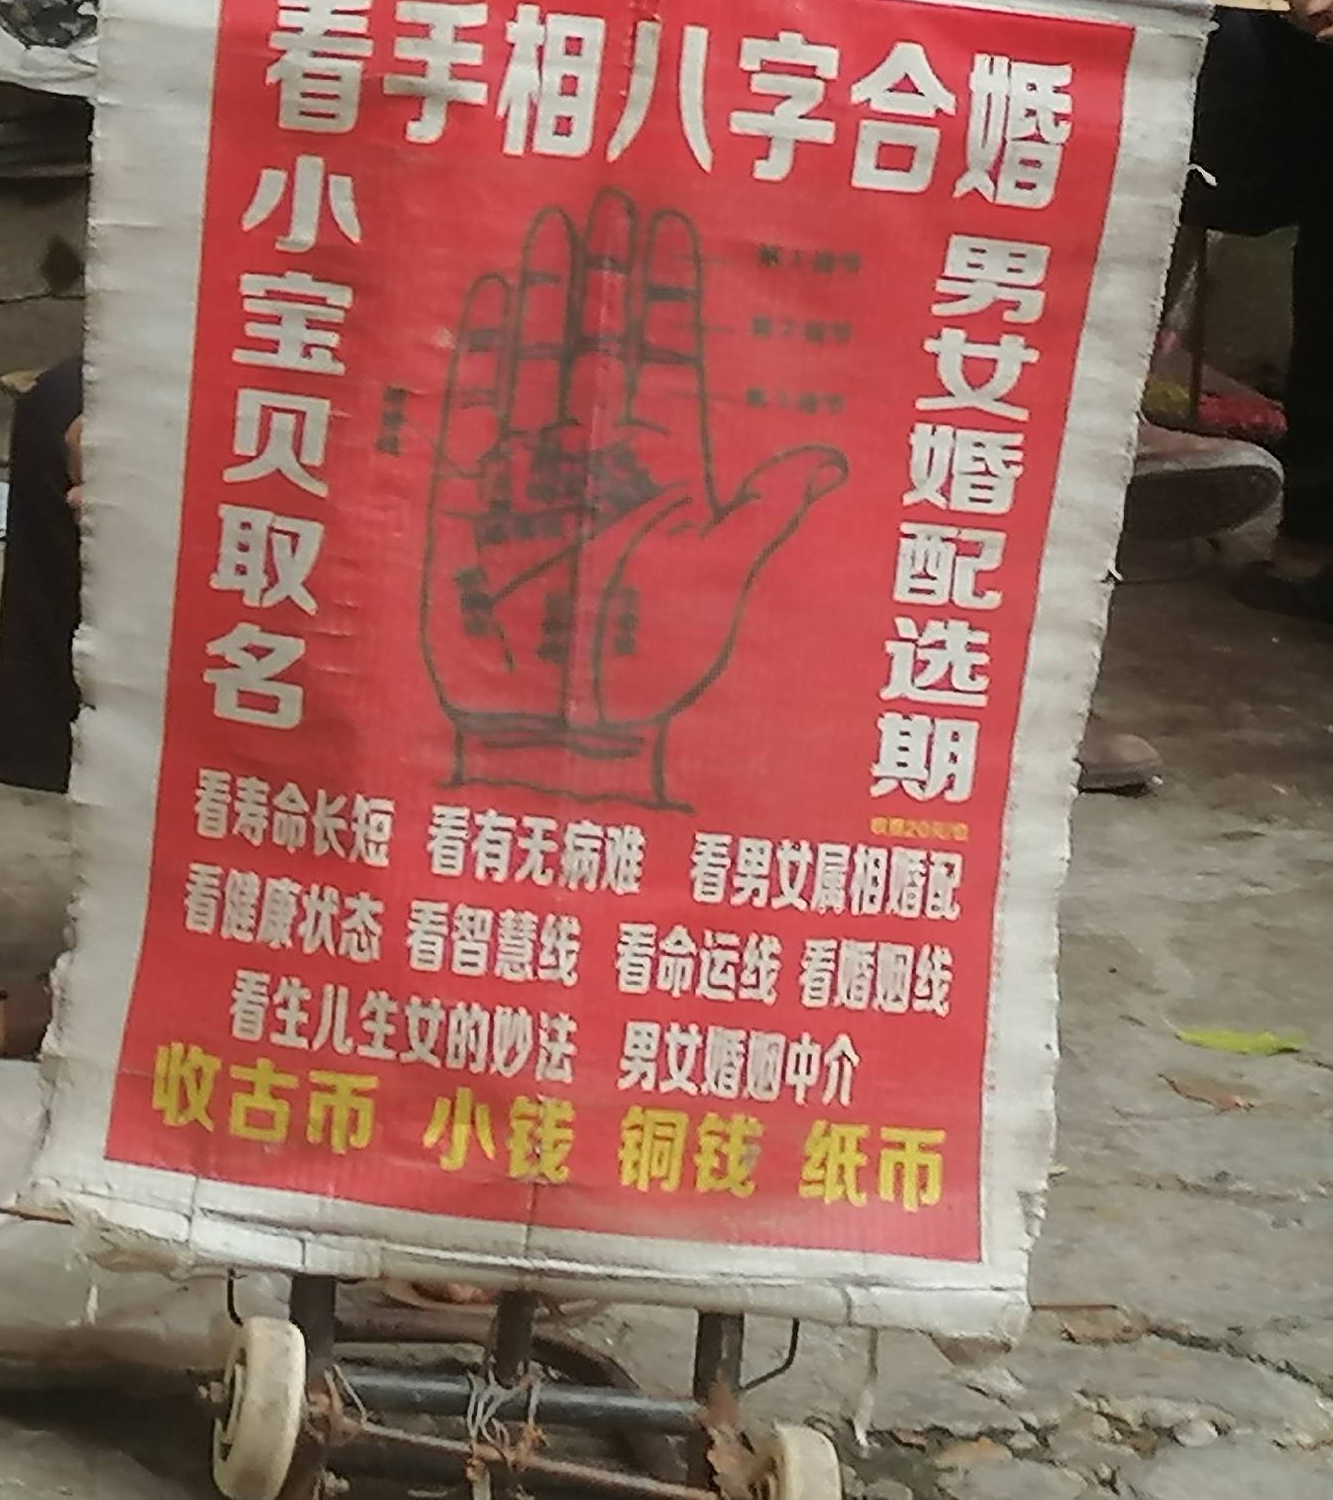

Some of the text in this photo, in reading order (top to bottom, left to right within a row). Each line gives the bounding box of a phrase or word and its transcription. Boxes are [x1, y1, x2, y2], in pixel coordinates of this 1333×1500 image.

[205, 155, 363, 730] 小宝贝取名
[869, 233, 1051, 803] 男女婚配选期
[194, 768, 964, 921] 看寿命长短 看有无病难 看男女属相婚配
[184, 862, 954, 1018] 看健康状态 看智慧线 看命运线 看婚姻线
[230, 969, 861, 1107] 看生儿生女的妙法 男女婚姻中介
[152, 1042, 946, 1214] 收古币 小钱 铜钱 纸币
